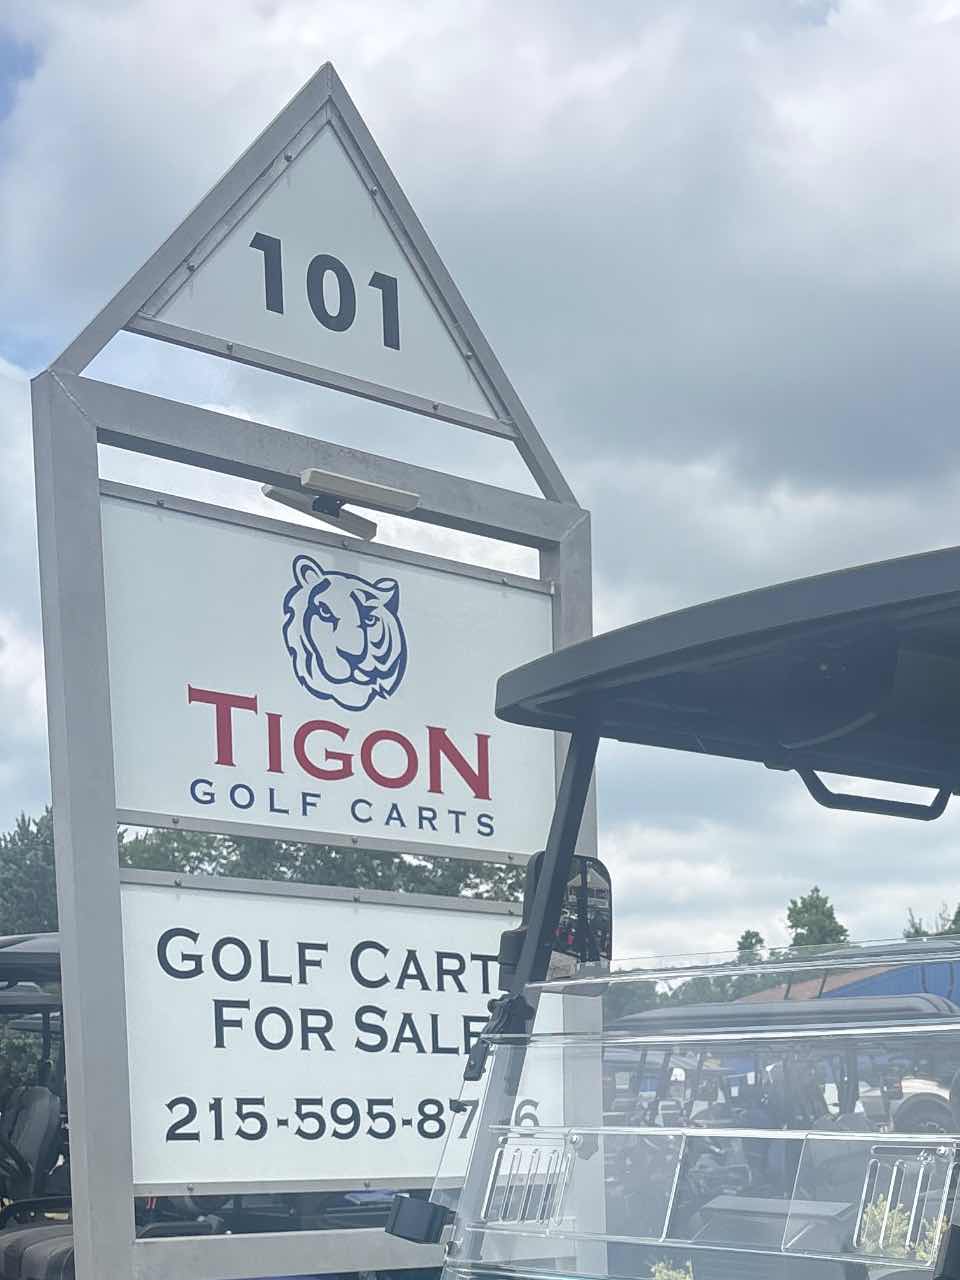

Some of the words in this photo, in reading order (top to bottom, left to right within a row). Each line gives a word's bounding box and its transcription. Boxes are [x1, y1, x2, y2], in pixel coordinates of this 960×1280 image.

[248, 231, 402, 351] 101
[187, 684, 492, 801] TIGON
[189, 778, 322, 817] GOLF
[350, 798, 495, 837] CARTS
[156, 927, 329, 985] GOLF
[212, 998, 335, 1052] FOR
[164, 1096, 541, 1143] 215-595-876
